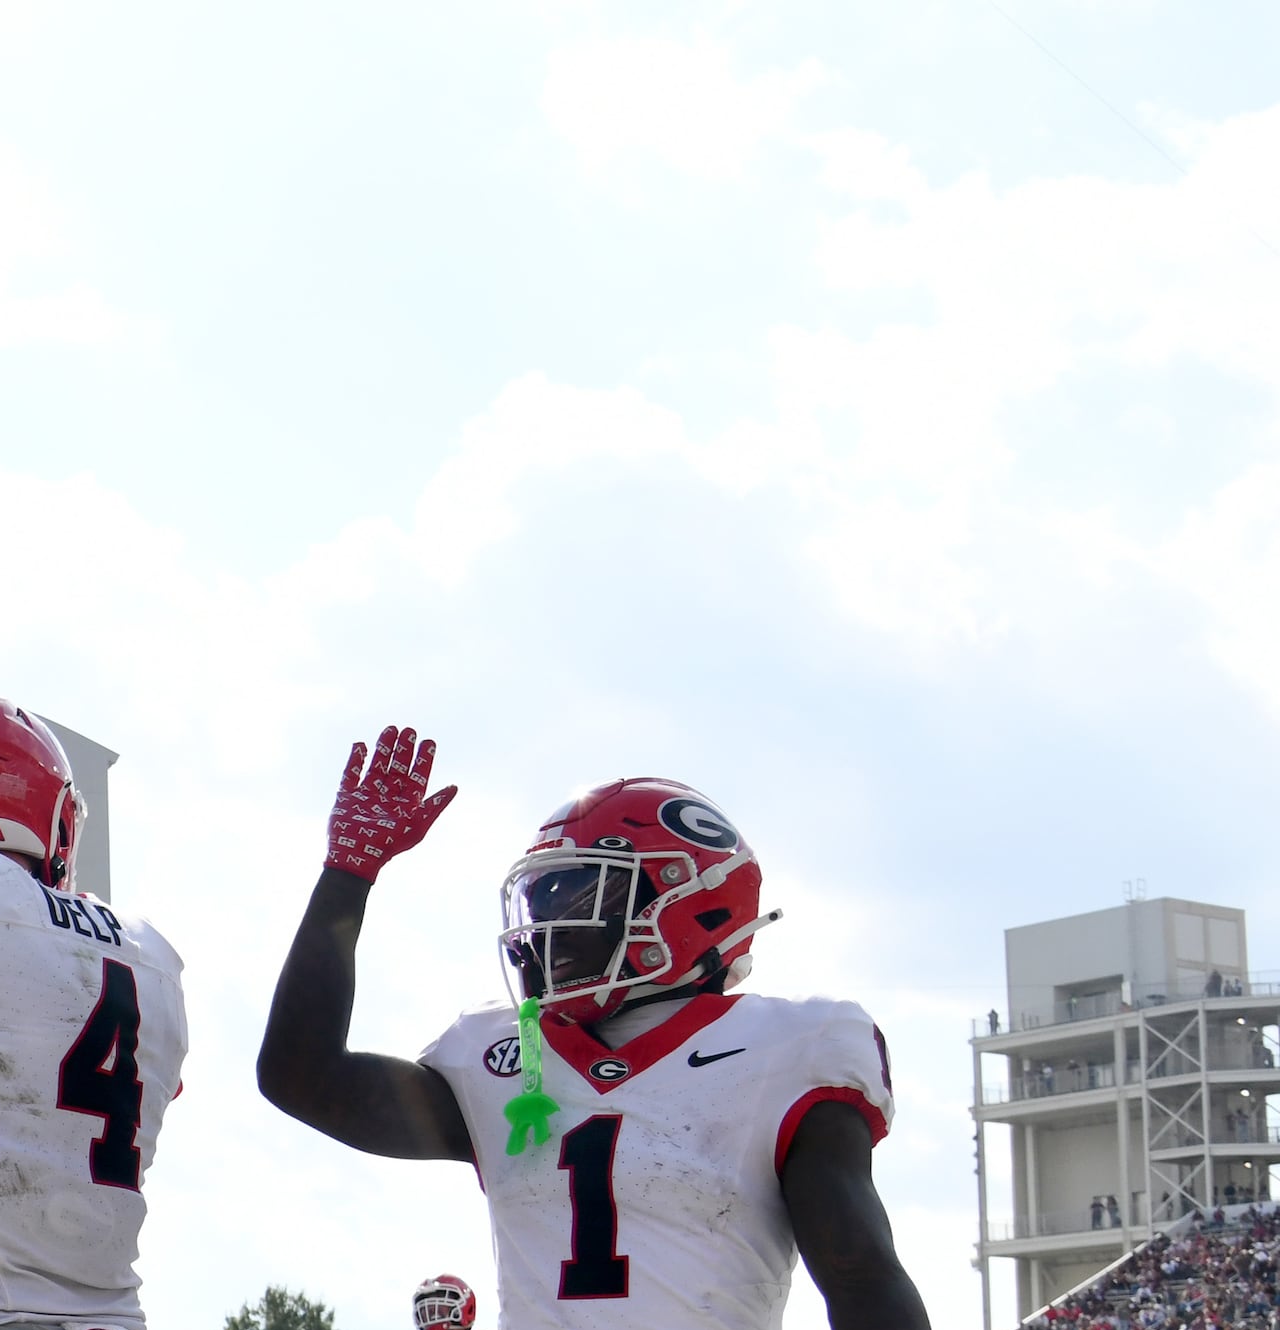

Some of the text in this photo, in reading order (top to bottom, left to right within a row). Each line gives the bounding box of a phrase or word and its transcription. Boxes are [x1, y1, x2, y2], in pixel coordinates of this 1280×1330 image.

[657, 798, 740, 852] G
[39, 885, 121, 947] DELP
[56, 957, 144, 1194] 4
[487, 1038, 523, 1072] SE
[589, 1058, 630, 1081] G
[558, 1114, 629, 1299] 1
